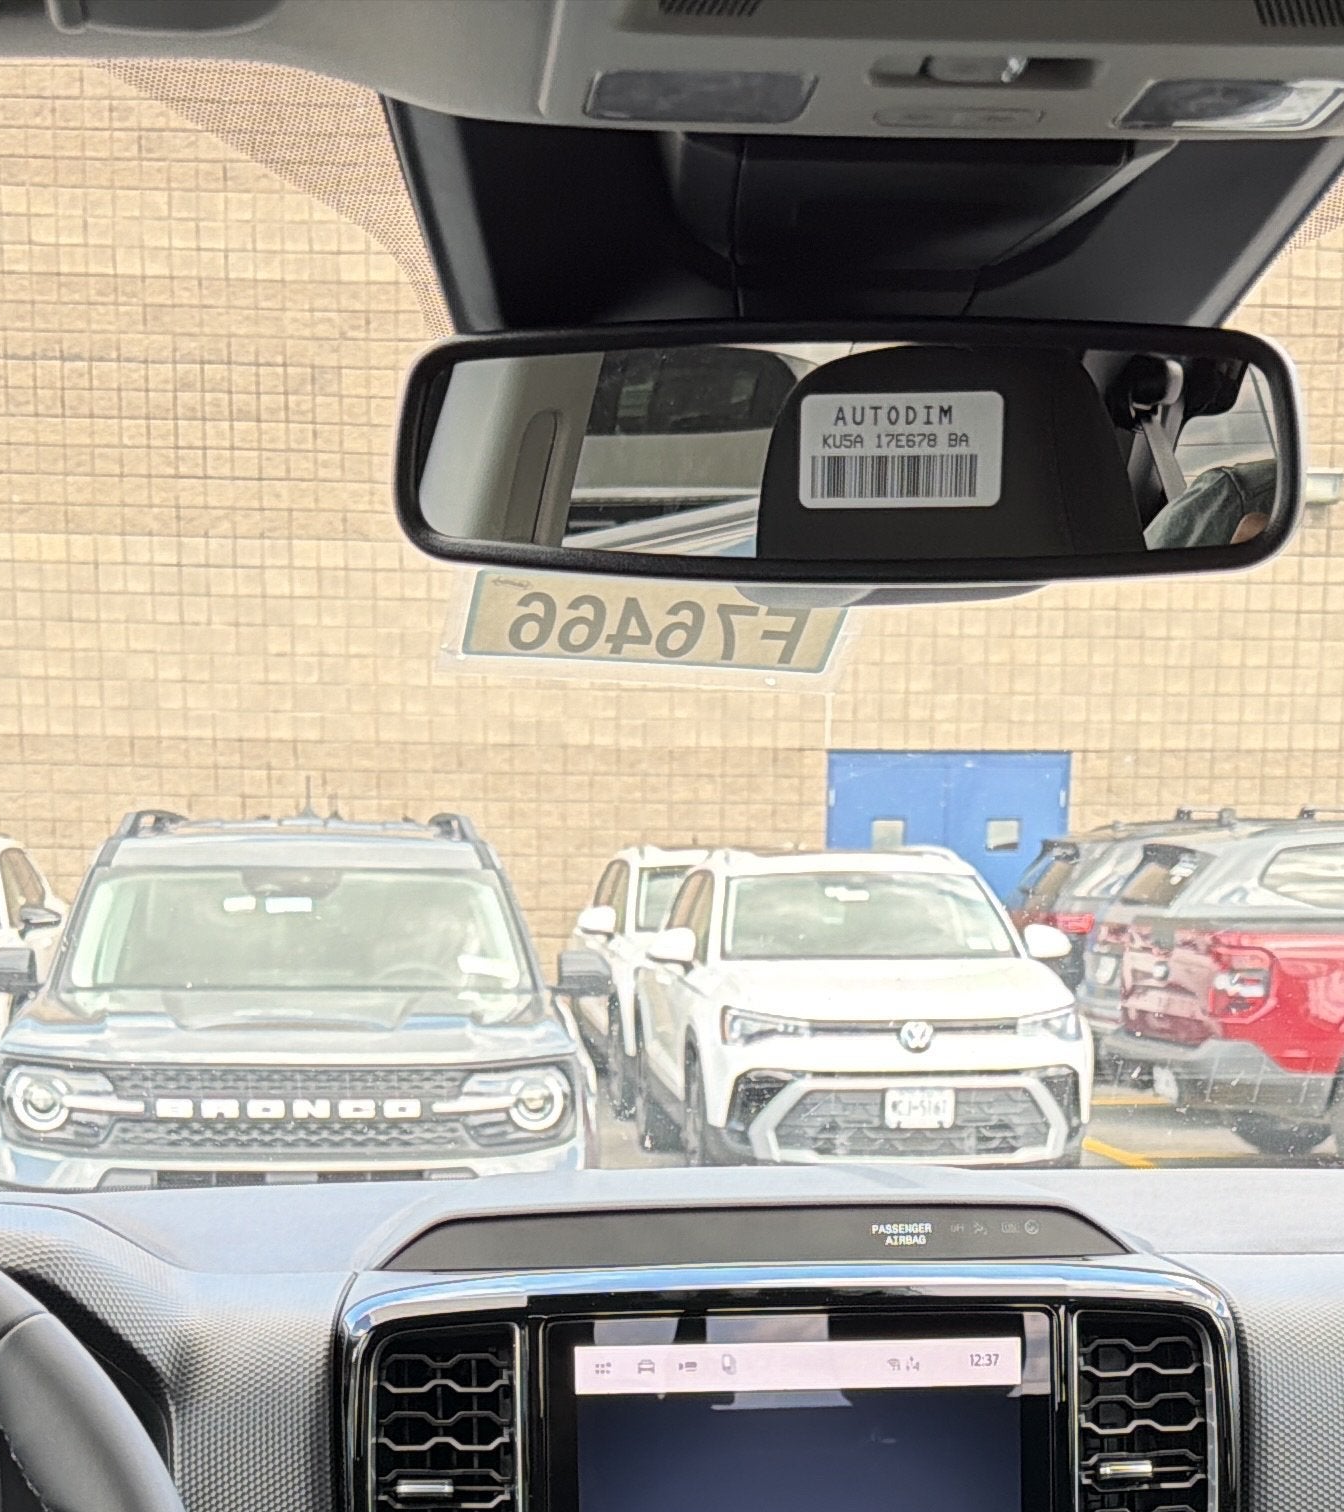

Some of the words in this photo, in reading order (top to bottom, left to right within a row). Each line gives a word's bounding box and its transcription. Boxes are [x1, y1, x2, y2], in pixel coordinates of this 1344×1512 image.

[833, 404, 953, 427] AUTODIM
[822, 434, 864, 449] KU5A
[875, 433, 938, 448] 17E678
[947, 432, 969, 448] BA
[156, 1098, 422, 1119] BRONCO
[871, 1222, 933, 1235] PASSENGER
[885, 1235, 927, 1246] AIRBAG
[969, 1352, 1000, 1368] 12:37
